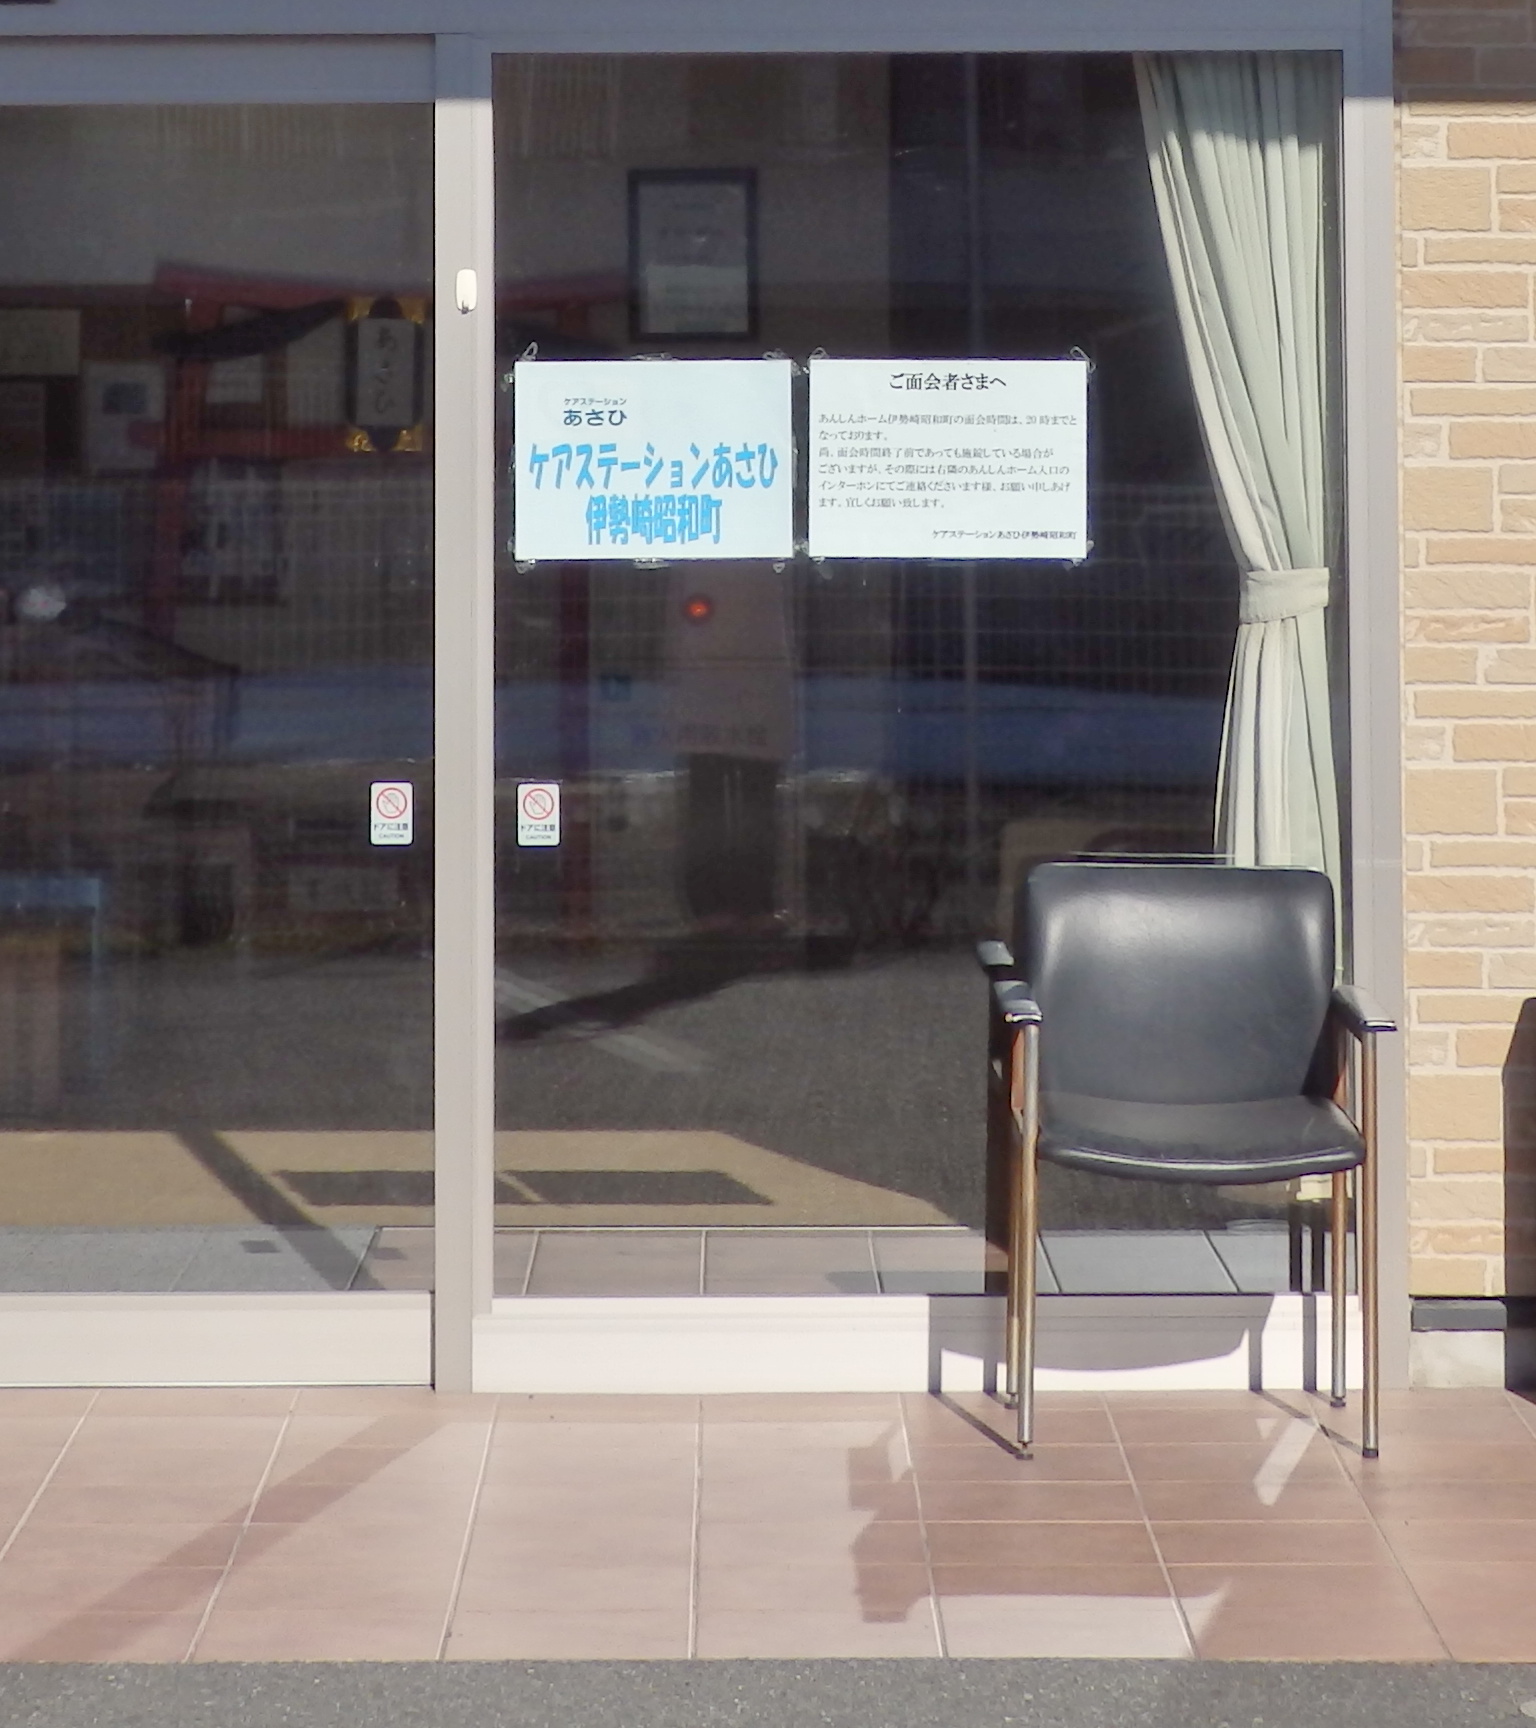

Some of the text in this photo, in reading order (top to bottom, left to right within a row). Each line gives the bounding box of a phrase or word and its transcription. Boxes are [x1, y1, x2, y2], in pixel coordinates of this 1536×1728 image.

[889, 372, 1008, 392] ご面会者さまへ
[563, 397, 627, 406] ケアステーション
[563, 408, 627, 427] あさひ
[529, 442, 779, 490] ケアステーションあさひ
[584, 493, 724, 546] 伊勢崎昭和町
